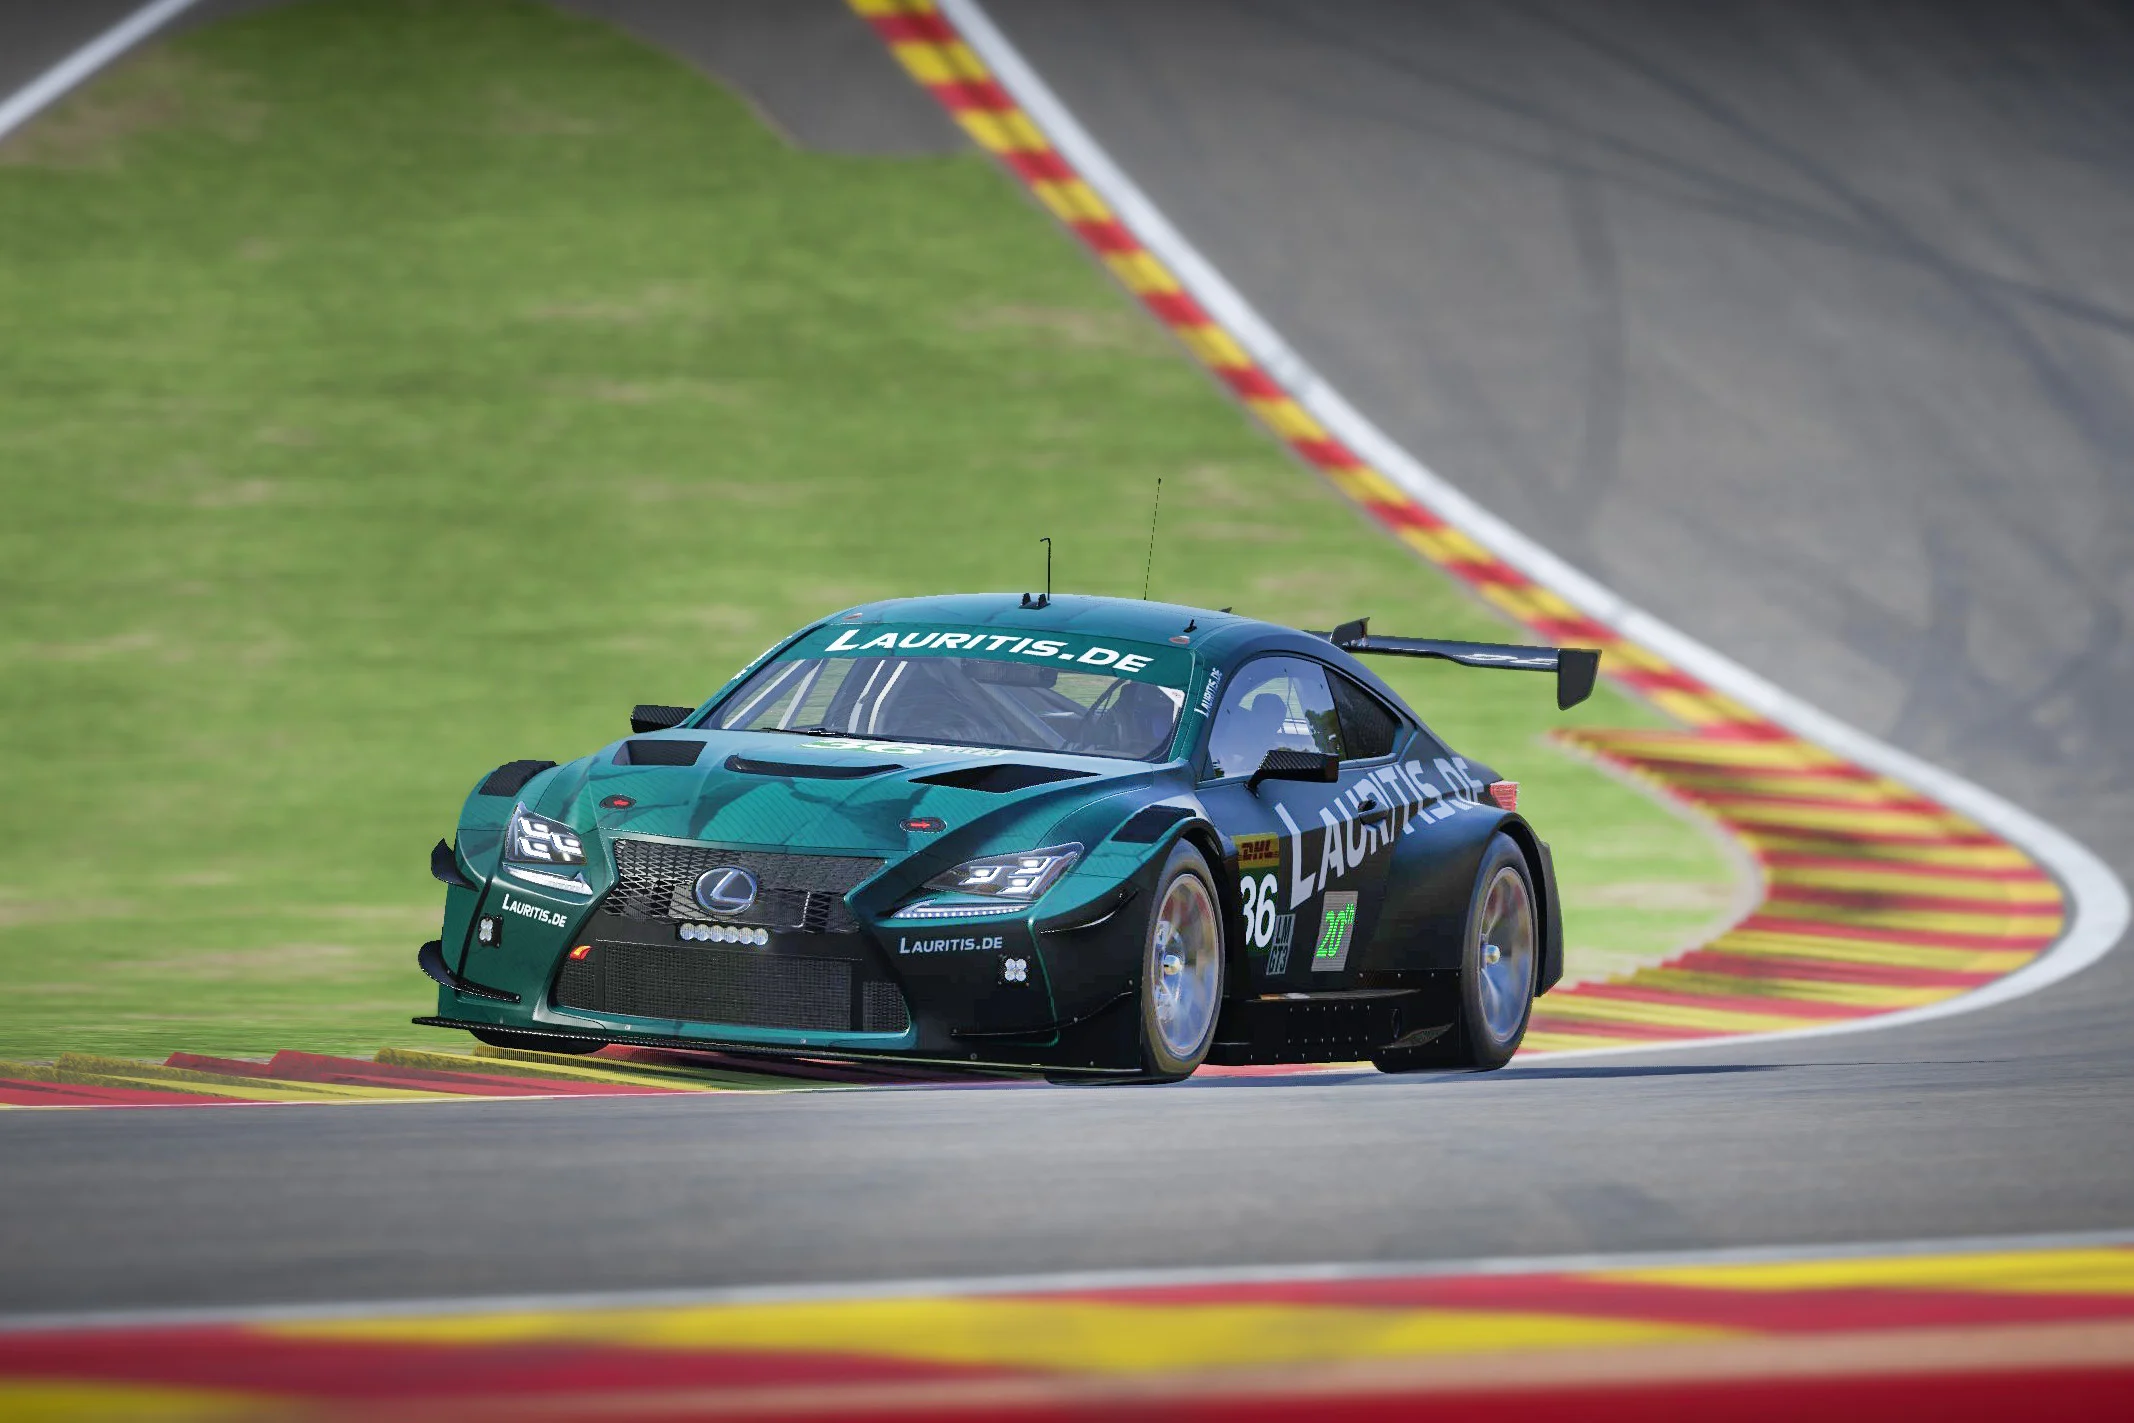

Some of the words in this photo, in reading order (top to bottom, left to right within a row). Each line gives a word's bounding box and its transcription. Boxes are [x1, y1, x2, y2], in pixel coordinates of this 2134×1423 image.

[825, 629, 1154, 673] LAURITIS.DE
[1194, 667, 1222, 718] LAURITIS.DE
[1241, 840, 1273, 860] DHL
[502, 893, 567, 928] LAURITIS.DE
[1240, 873, 1278, 948] 36
[900, 937, 1003, 954] LAURITIS.DE
